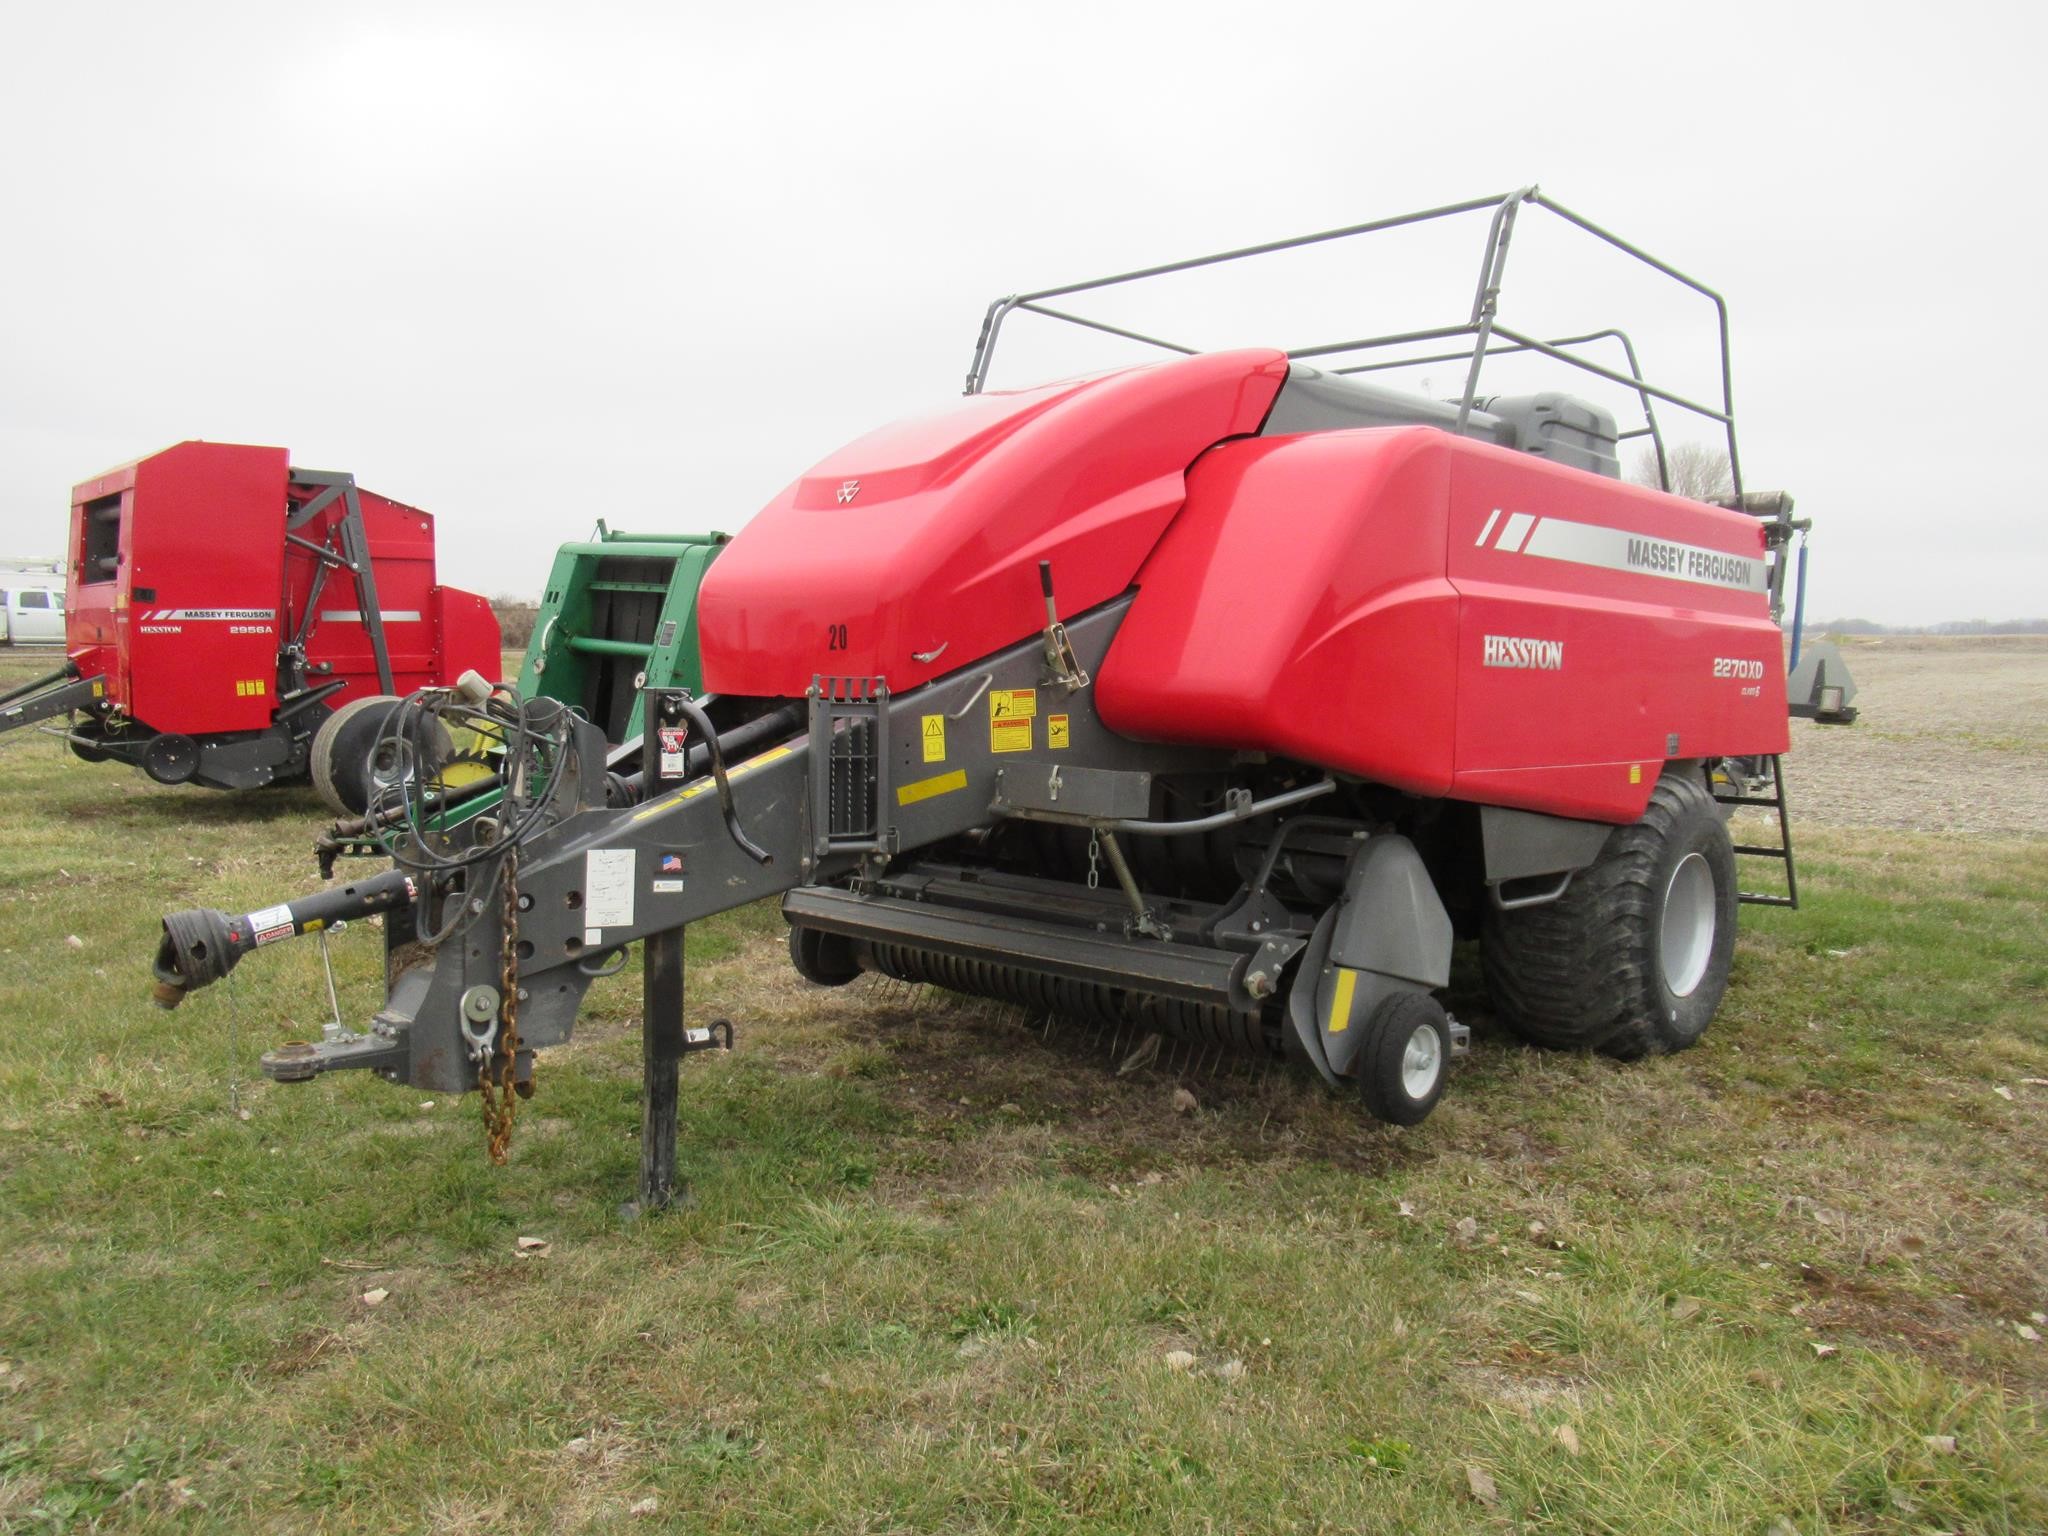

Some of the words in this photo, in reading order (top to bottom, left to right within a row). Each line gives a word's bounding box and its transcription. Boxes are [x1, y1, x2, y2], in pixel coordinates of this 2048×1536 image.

[1627, 538, 1685, 574] MASSEY
[1687, 550, 1751, 584] FERGUSON
[140, 625, 182, 633] HESSTON
[829, 624, 848, 651] 20
[1484, 634, 1564, 671] HESSTON
[1713, 657, 1764, 679] 2270XD
